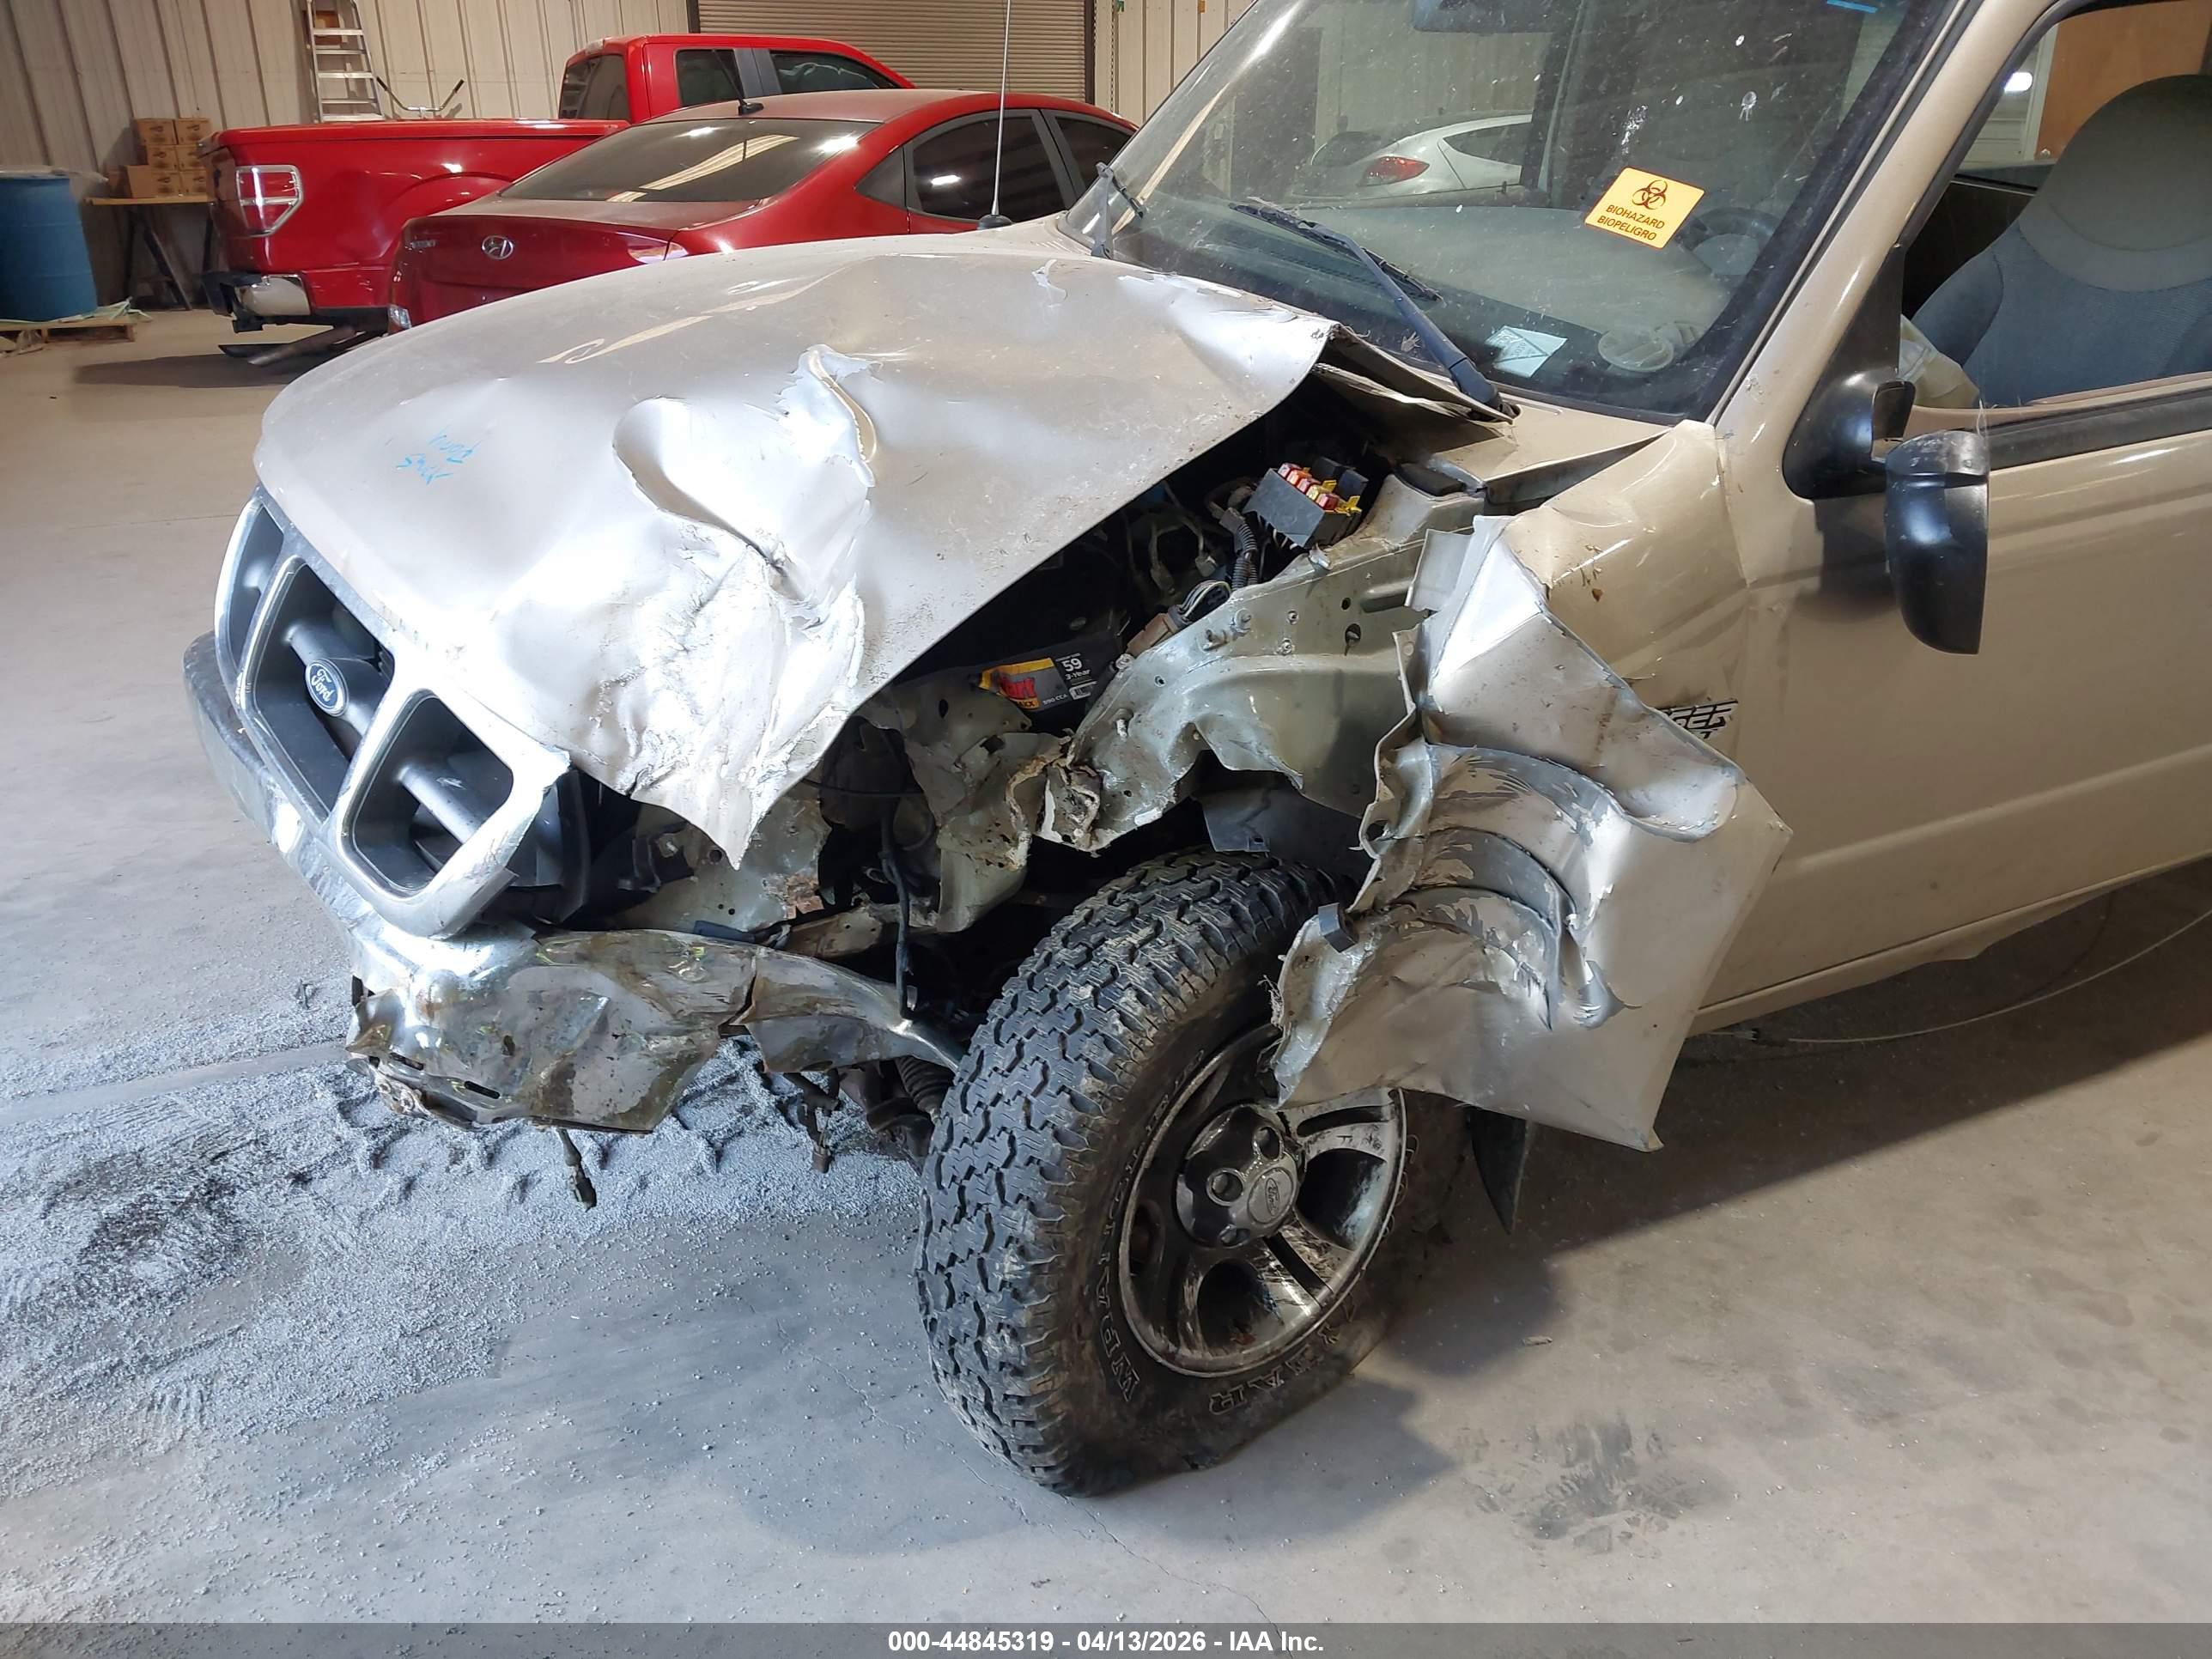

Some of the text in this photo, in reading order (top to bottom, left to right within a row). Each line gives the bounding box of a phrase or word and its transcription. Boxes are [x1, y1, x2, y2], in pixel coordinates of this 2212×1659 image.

[1597, 215, 1657, 240] BIOPELIGRO
[1606, 204, 1665, 229] BIOHAZARD
[1061, 658, 1083, 672] 59
[1065, 669, 1091, 680] 3-Year
[311, 668, 335, 702] Ford
